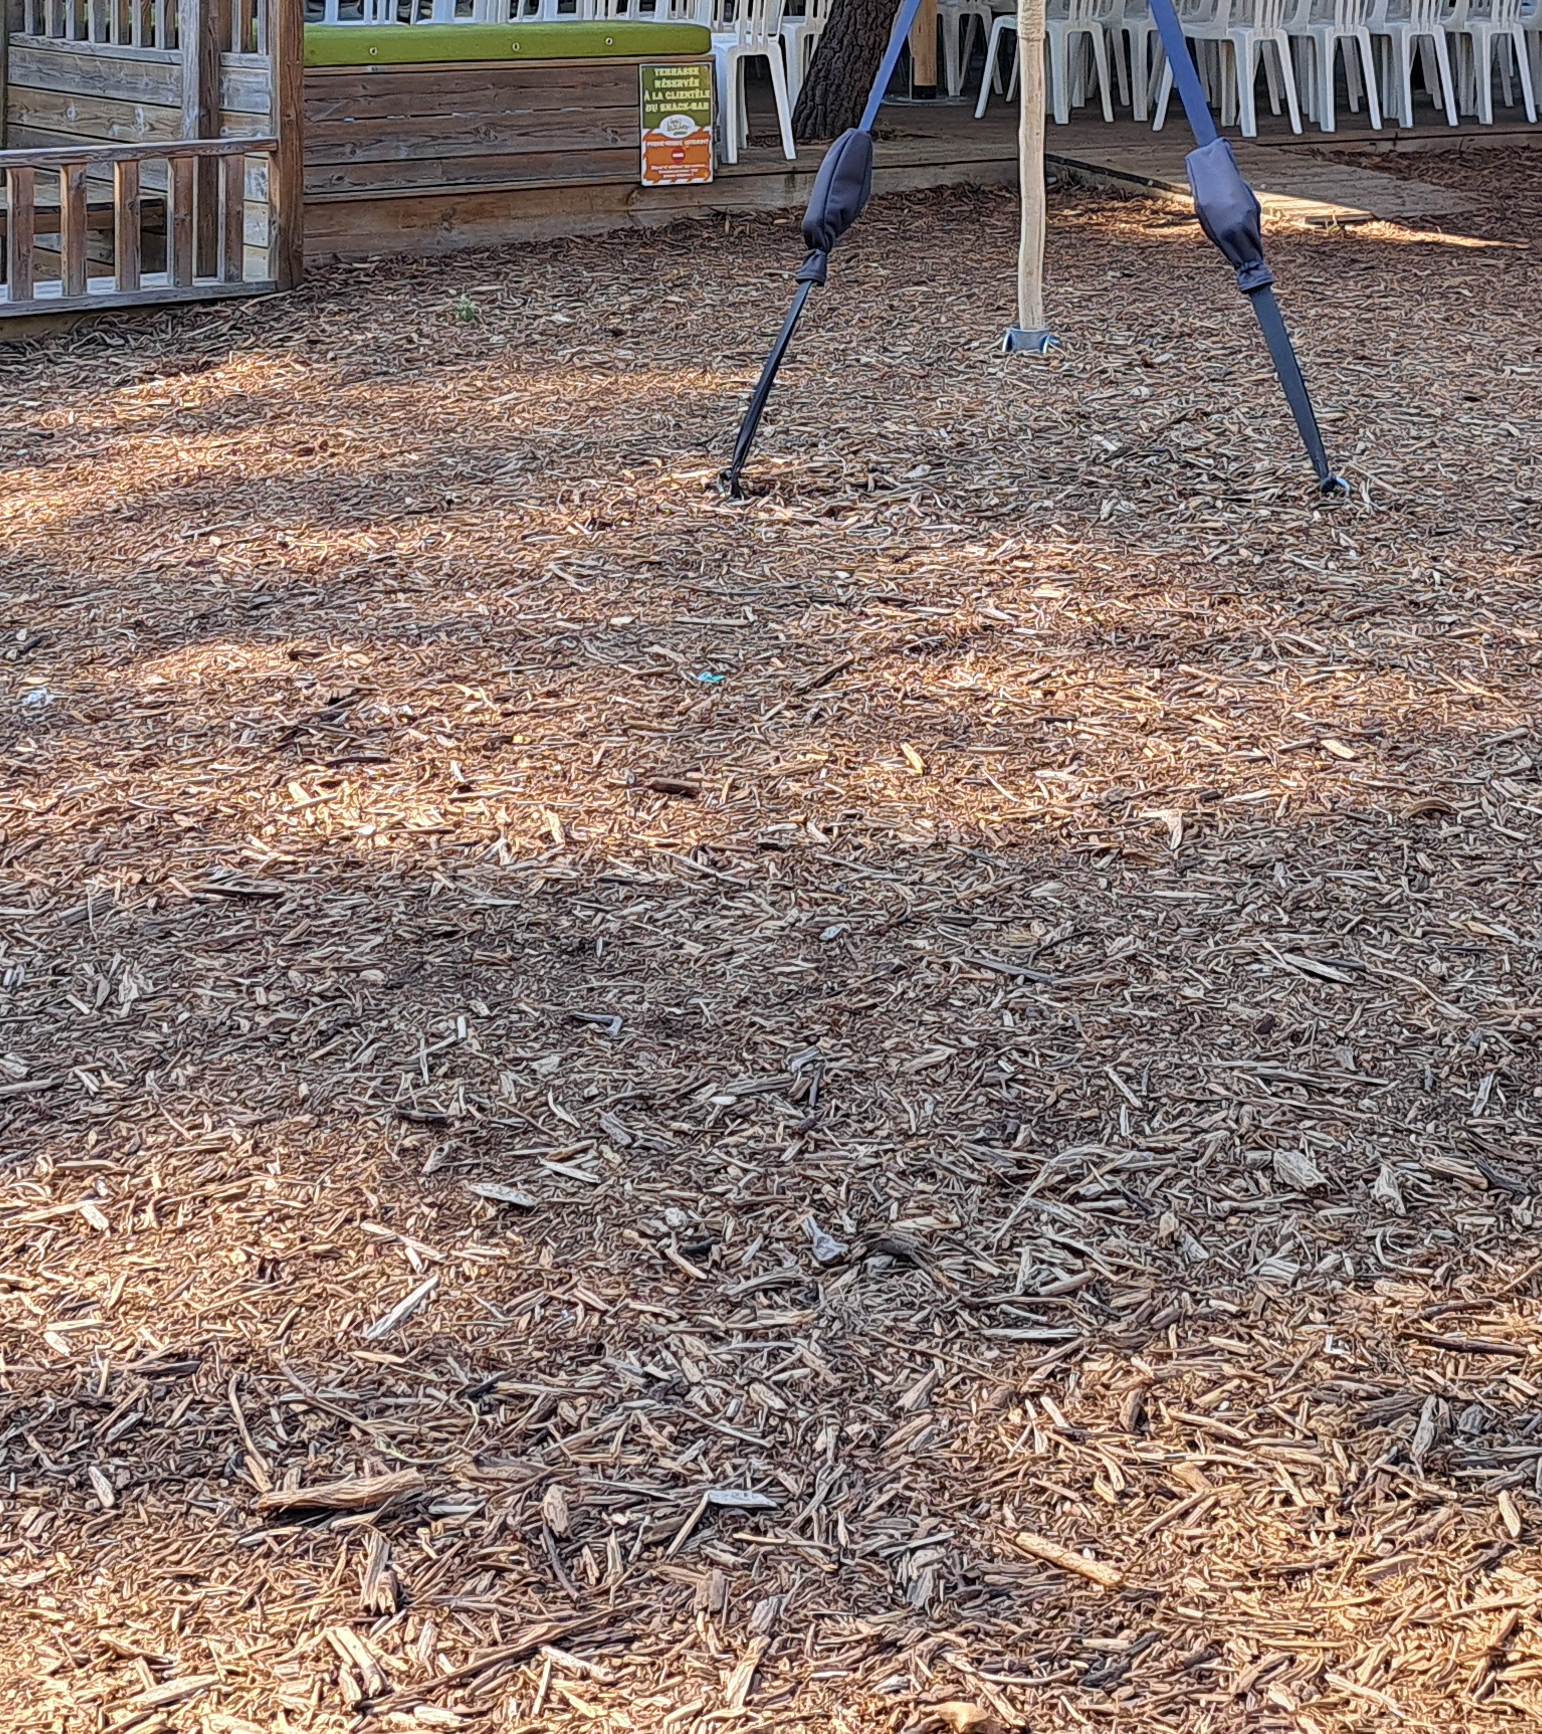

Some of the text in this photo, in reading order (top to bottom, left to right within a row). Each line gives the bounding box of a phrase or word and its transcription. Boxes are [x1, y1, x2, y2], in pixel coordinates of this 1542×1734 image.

[654, 67, 700, 77] TERRASSE
[654, 77, 700, 89] RÉSERVÉE
[652, 91, 664, 101] LA
[665, 88, 711, 100] CLIENTÈLE
[645, 102, 709, 113] DU SNACK-BAR
